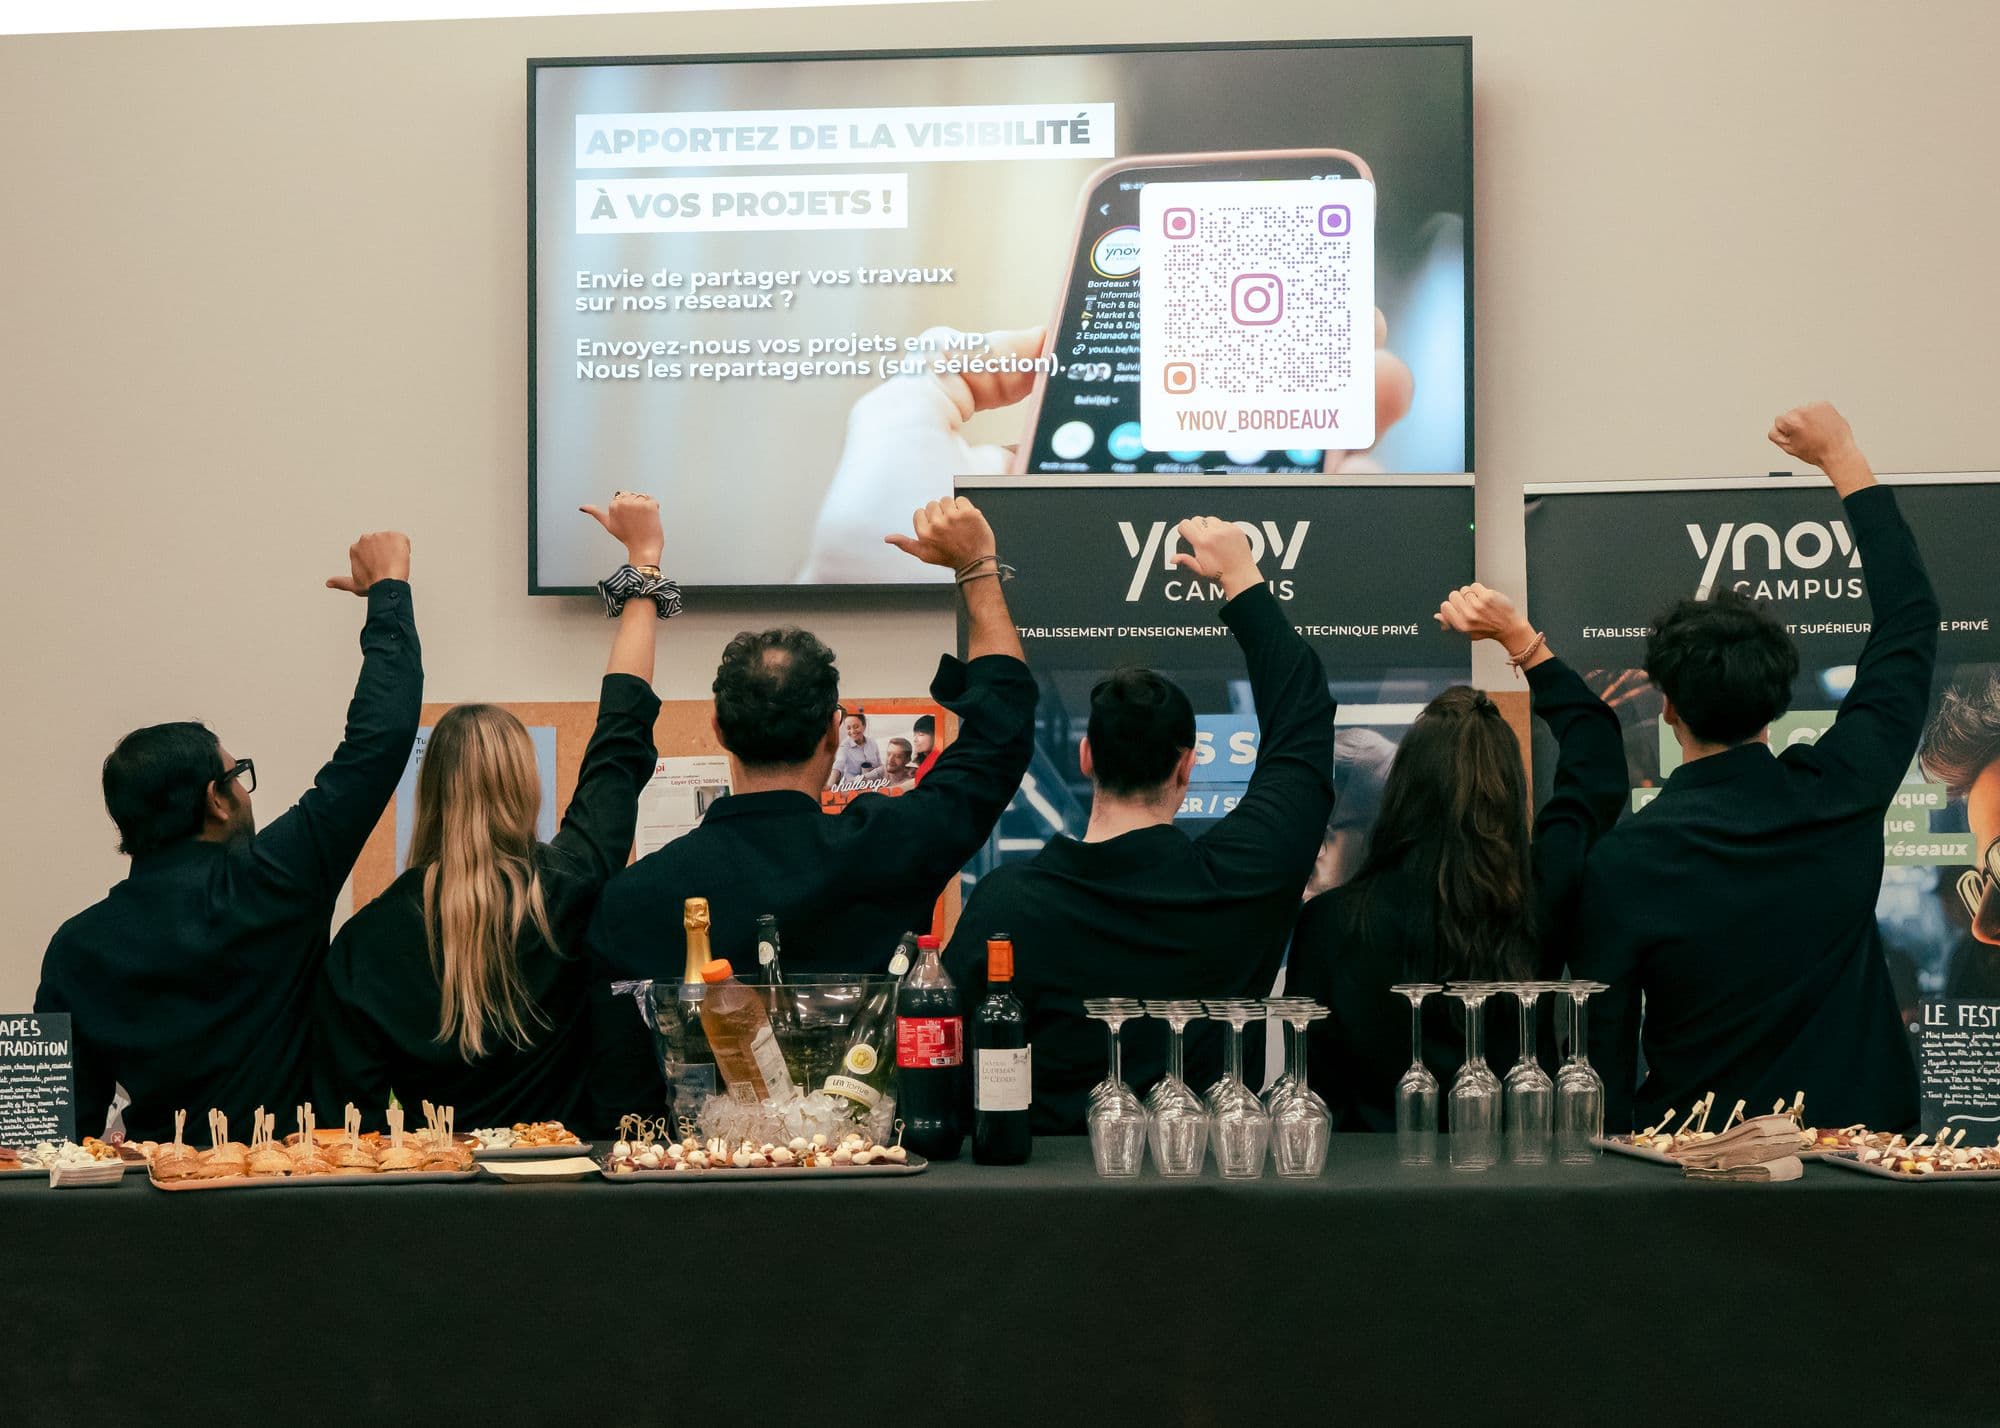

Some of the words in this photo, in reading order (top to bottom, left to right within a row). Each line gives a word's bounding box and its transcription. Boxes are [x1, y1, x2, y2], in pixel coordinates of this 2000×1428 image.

[586, 126, 779, 154] APPORTEZ
[790, 125, 838, 150] DE
[849, 123, 896, 149] LA
[905, 112, 1090, 148] VISIBILITÉ
[590, 188, 617, 219] À
[627, 193, 701, 218] VOS
[712, 189, 871, 217] PROJETS
[882, 189, 892, 214] !
[576, 269, 644, 288] Envie
[651, 268, 682, 287] de
[691, 268, 800, 294] partager
[808, 272, 851, 284] vos
[857, 266, 954, 284] travaux
[1088, 280, 1130, 288] Bordeaux
[575, 294, 615, 311] sur
[622, 294, 667, 310] nos
[675, 290, 773, 309] réseaux
[780, 289, 794, 309] ?
[1097, 301, 1117, 309] Tech
[1119, 301, 1126, 309] &
[1096, 311, 1126, 319] Market
[1094, 321, 1115, 329] Créa
[1076, 332, 1082, 340] 2
[1084, 332, 1128, 341] Esplanade
[576, 337, 751, 360] Envoyez-nous
[757, 338, 801, 353] vos
[808, 332, 896, 357] projets
[904, 337, 936, 352] en
[944, 332, 990, 353] MP,
[576, 359, 640, 379] Nous
[647, 359, 682, 378] les
[689, 357, 871, 381] repartagerons
[878, 356, 926, 378] (sur
[934, 353, 1066, 376] séléction).
[1176, 409, 1339, 432] YNOV_BORDEAUX
[1165, 580, 1294, 601] CAMS
[1118, 625, 1229, 637] D'ENSEIGNEMENT
[1306, 625, 1378, 637] TECHNIQUE
[1383, 623, 1418, 635] PRIVÉ
[1800, 622, 1871, 634] SUPÉRIEUR
[1952, 618, 1989, 630] PRIVÉ
[831, 775, 891, 793] challenge
[1885, 841, 1968, 856] réseaux
[1925, 1004, 1949, 1026] LE
